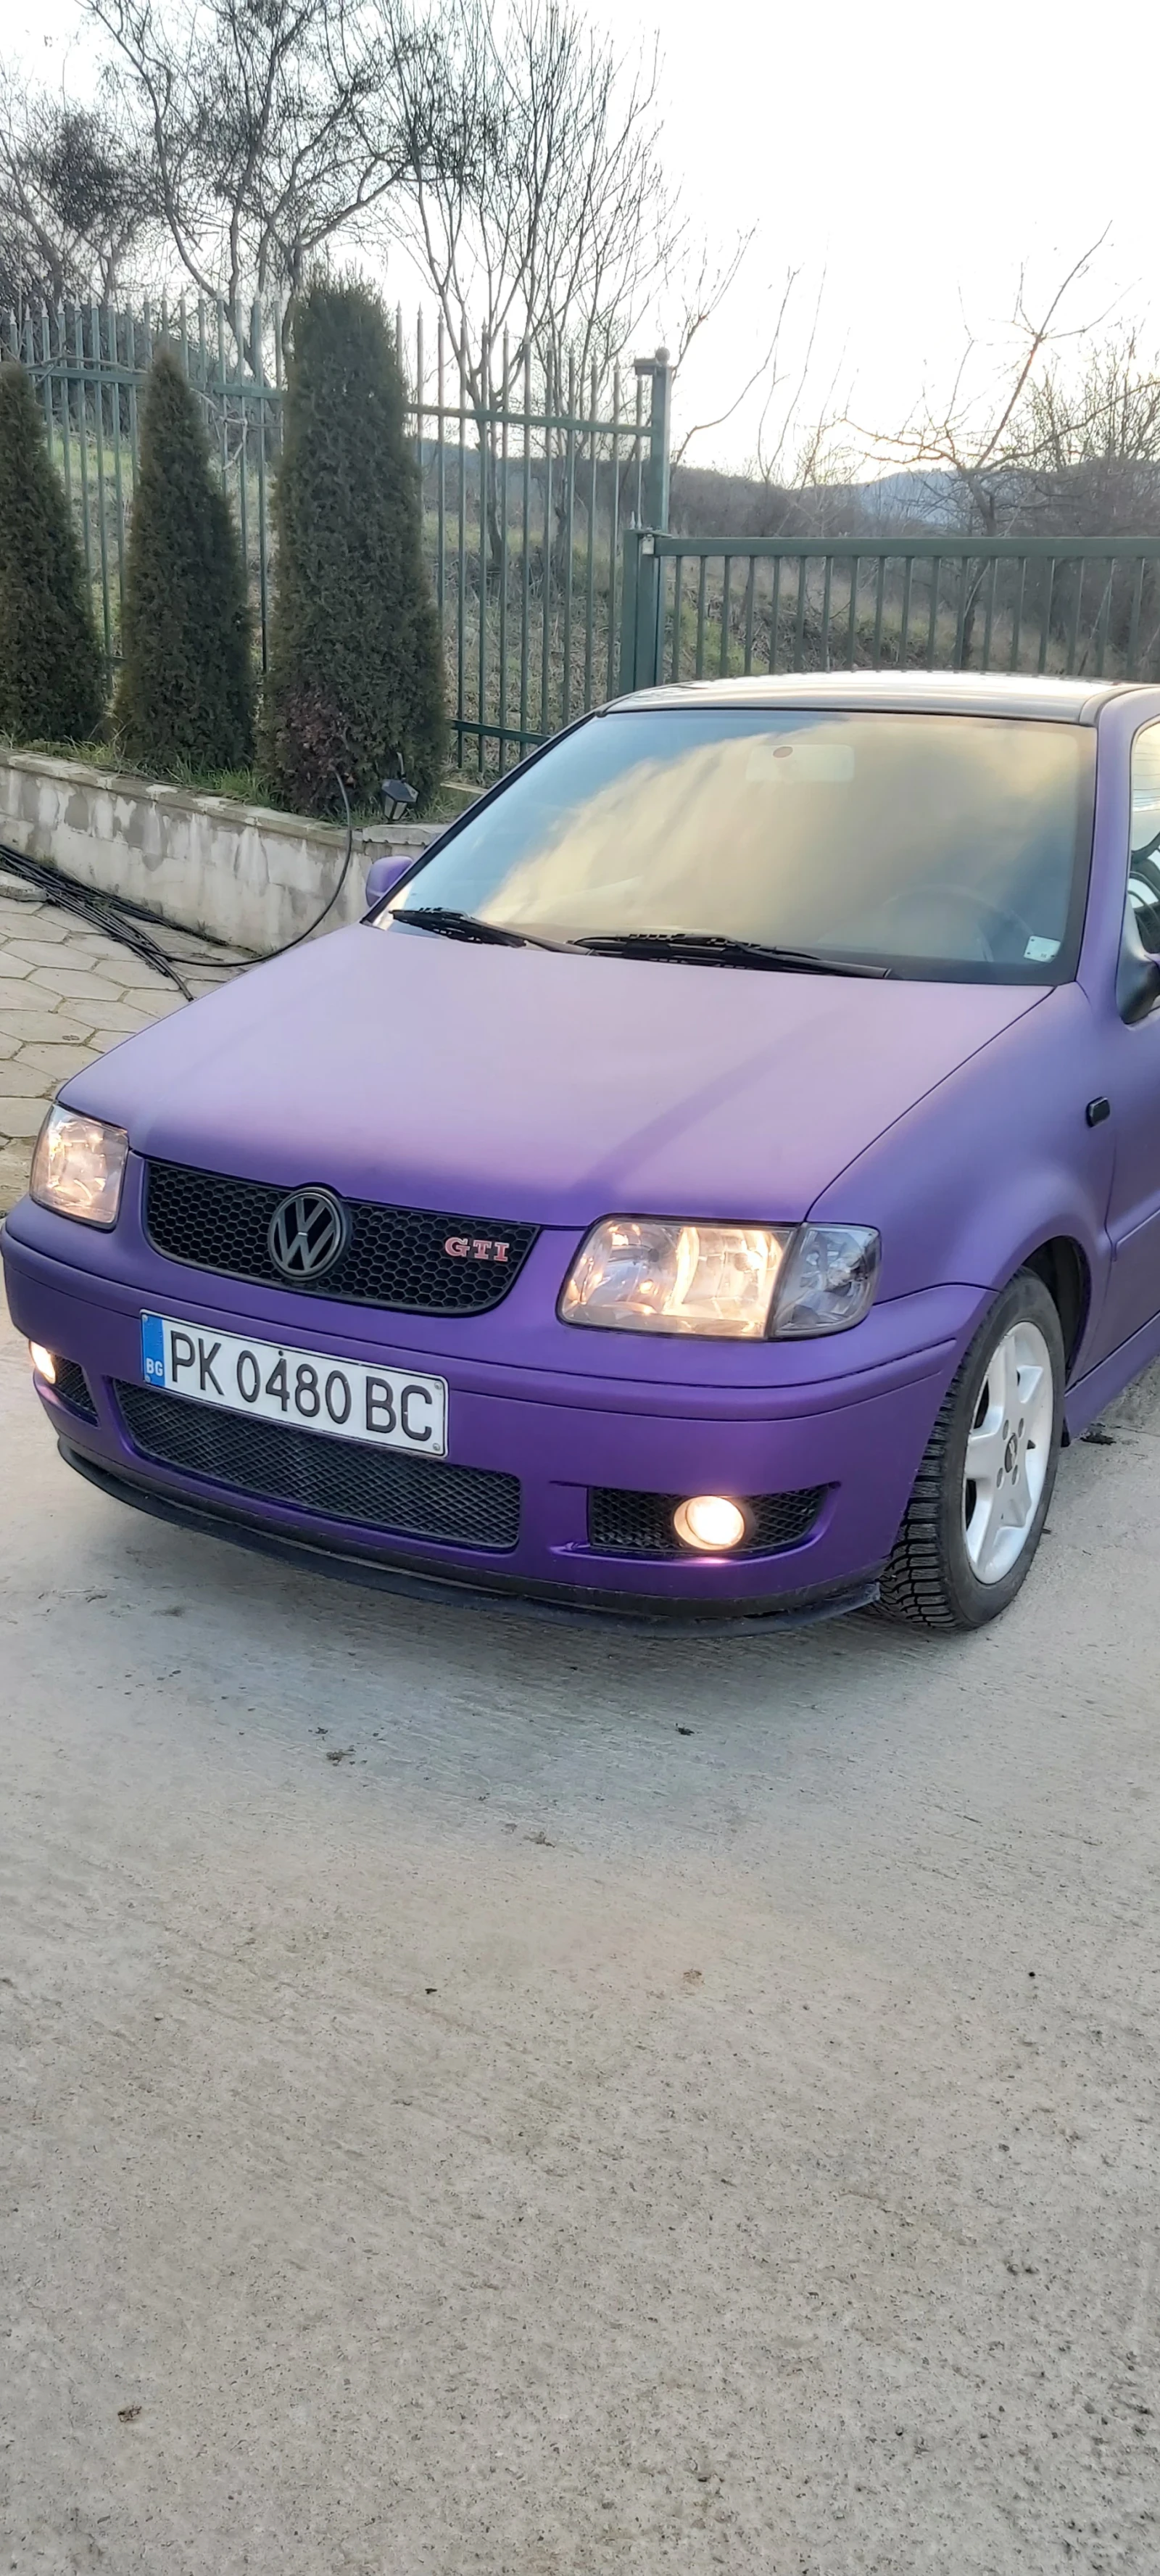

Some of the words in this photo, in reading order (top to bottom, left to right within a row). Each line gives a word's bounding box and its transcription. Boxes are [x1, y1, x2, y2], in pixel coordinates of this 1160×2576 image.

[275, 1197, 336, 1271] VW
[444, 1237, 510, 1261] GTI
[146, 1357, 164, 1377] BG
[170, 1330, 225, 1395] PK
[236, 1350, 352, 1424] 0480
[365, 1376, 433, 1442] BC
